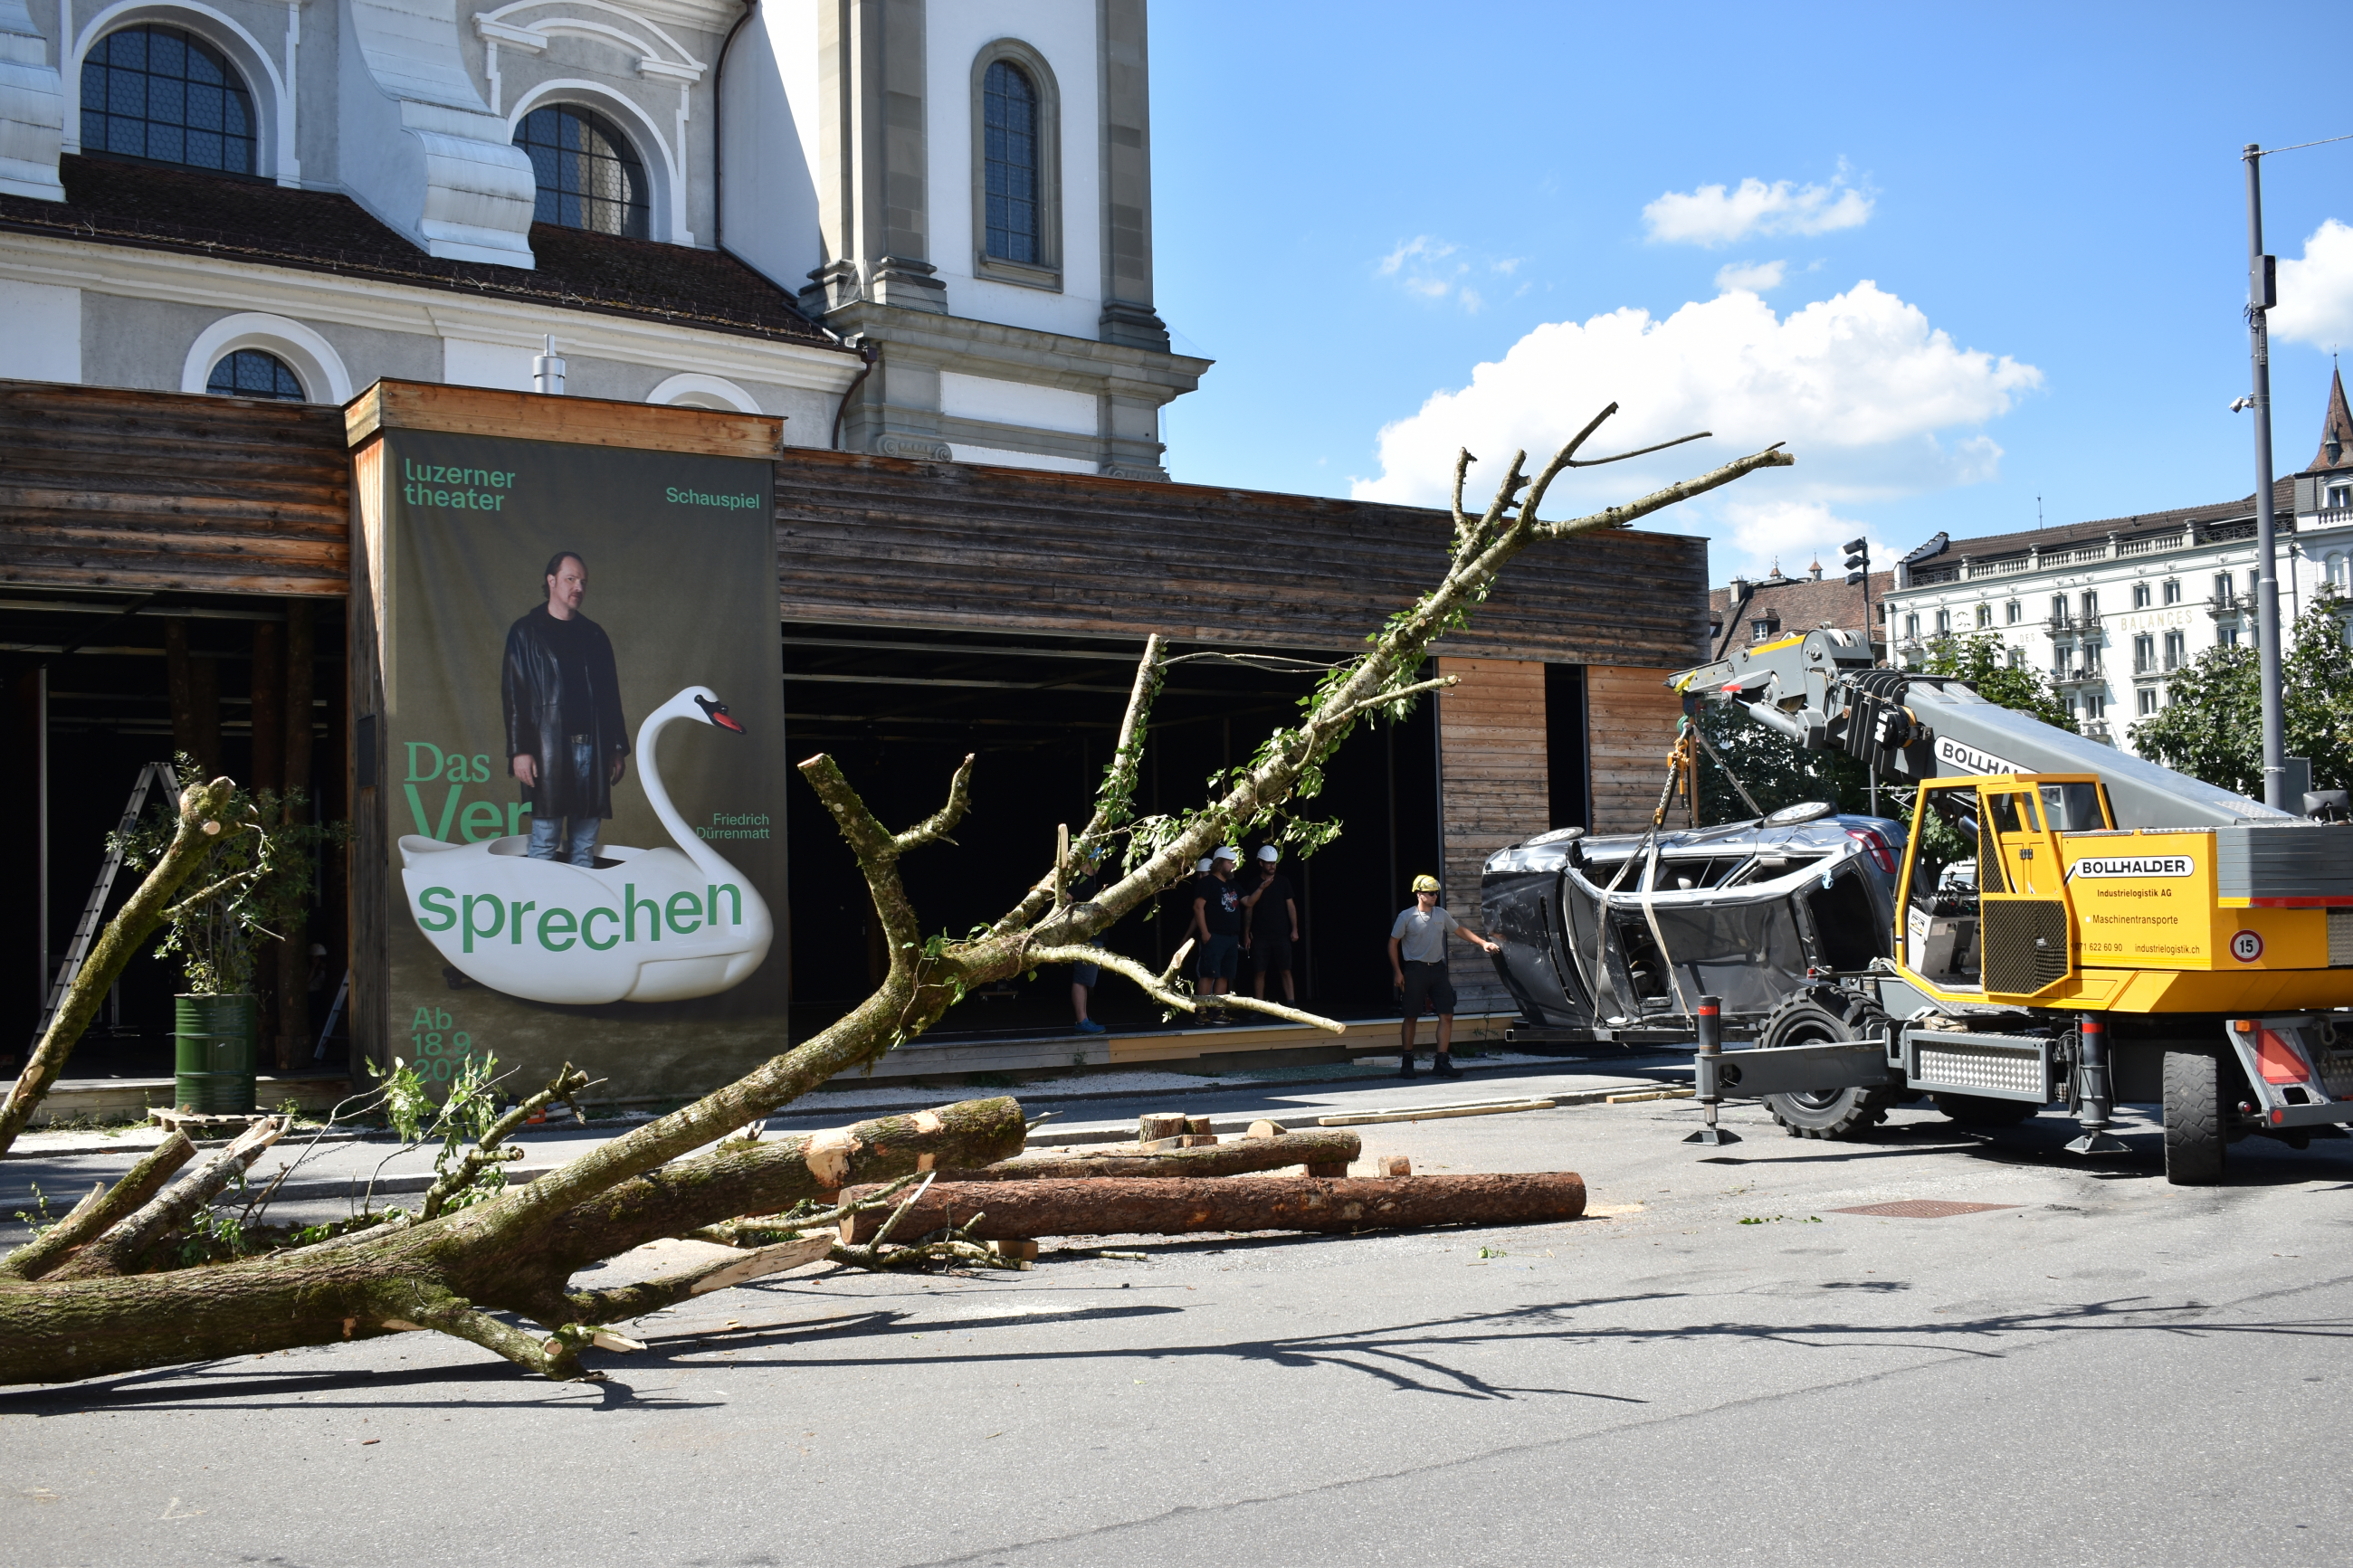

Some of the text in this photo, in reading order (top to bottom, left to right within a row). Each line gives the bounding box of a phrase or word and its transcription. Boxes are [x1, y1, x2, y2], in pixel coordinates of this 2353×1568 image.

[405, 458, 516, 489] luzerner
[404, 482, 505, 511] theater
[666, 487, 759, 511] Schauspiel
[2120, 609, 2193, 632] BALANCES
[404, 741, 491, 783] Das
[403, 784, 532, 844] Ver
[713, 813, 769, 825] Friedrich
[696, 826, 770, 839] Dürrenmatt
[2082, 860, 2186, 874] BOLLHALDER
[2097, 889, 2172, 898] Industrielogistik AG
[418, 883, 742, 954] sprechen
[2092, 914, 2178, 927] Maschinentransporte
[2089, 942, 2101, 951] 622
[2103, 943, 2112, 951] 60
[2114, 943, 2123, 952] 90
[2135, 944, 2200, 955] industrielogistik.ch
[2240, 939, 2253, 953] 15
[411, 1007, 452, 1031] Ab
[411, 1031, 479, 1057] 18.9.
